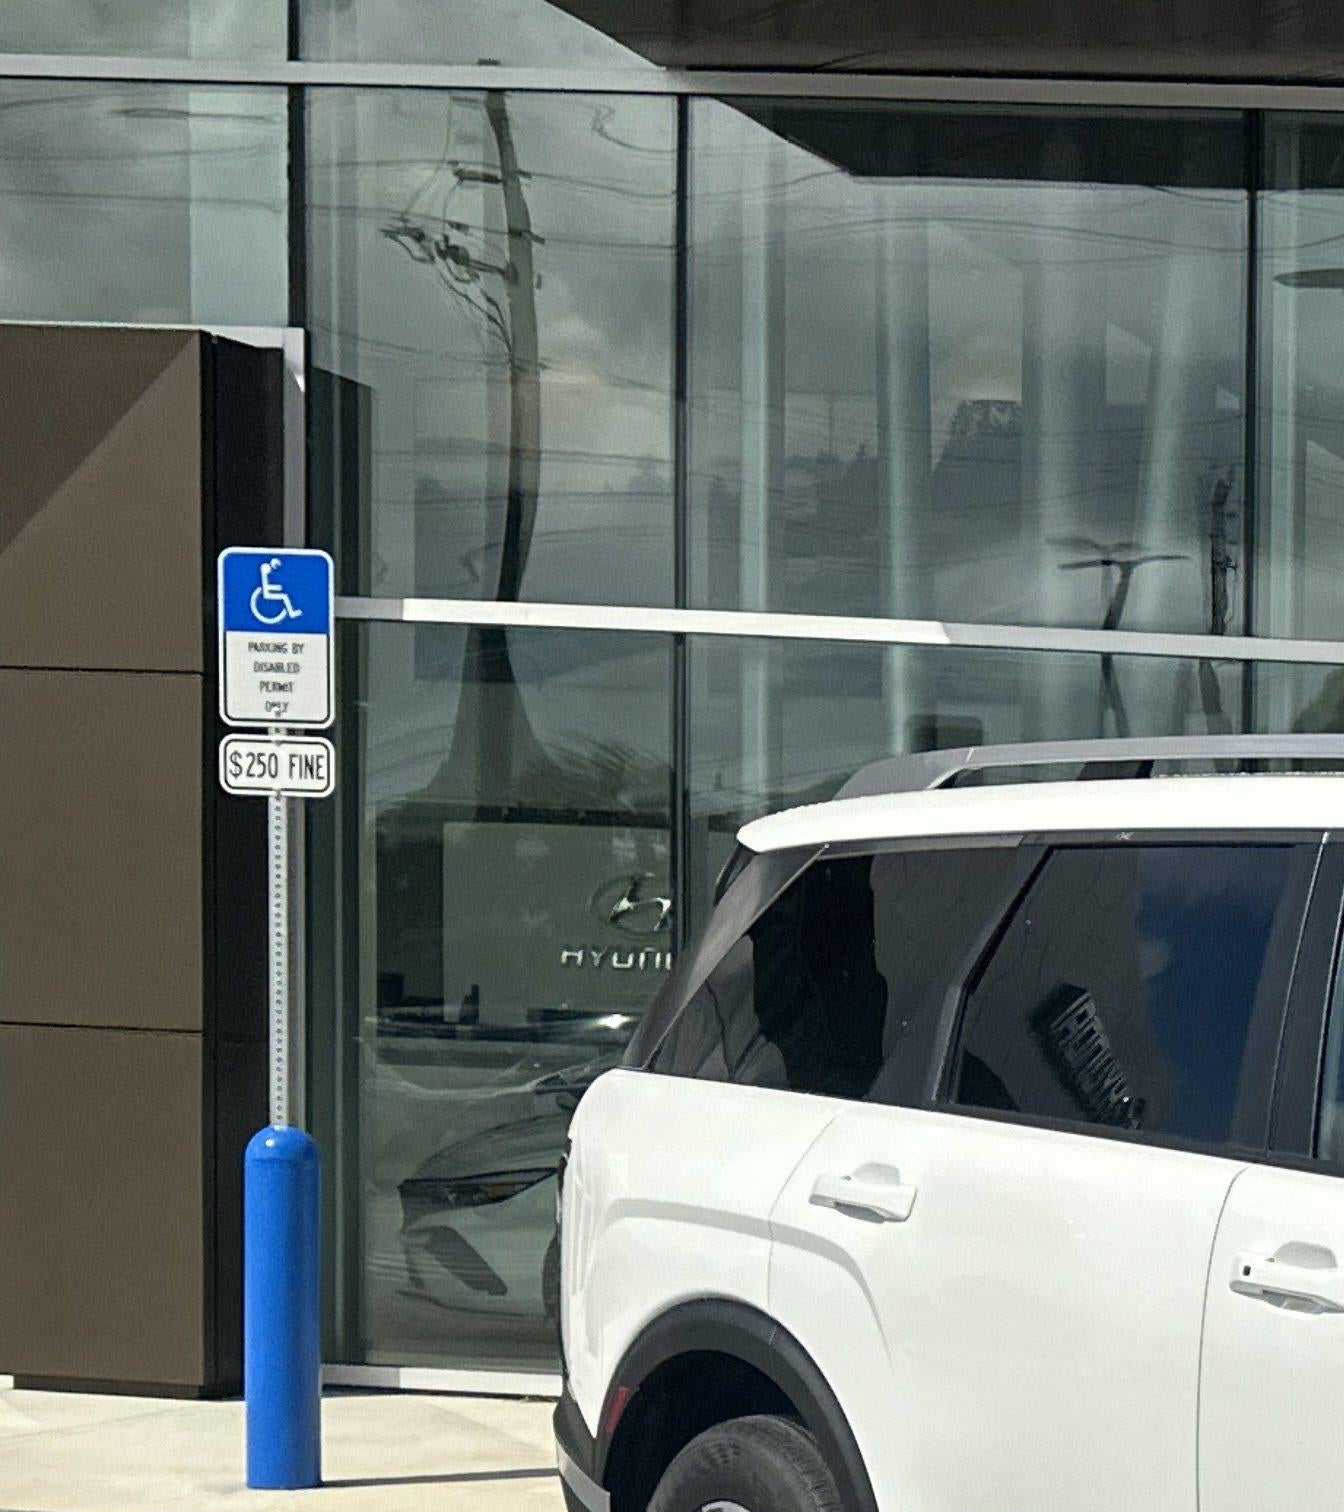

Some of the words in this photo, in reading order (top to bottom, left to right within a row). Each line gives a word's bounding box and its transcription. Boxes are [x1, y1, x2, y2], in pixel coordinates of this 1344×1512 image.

[292, 643, 304, 655] BY
[229, 750, 279, 780] $250
[288, 753, 325, 780] FINE
[560, 946, 672, 970] HYUN
